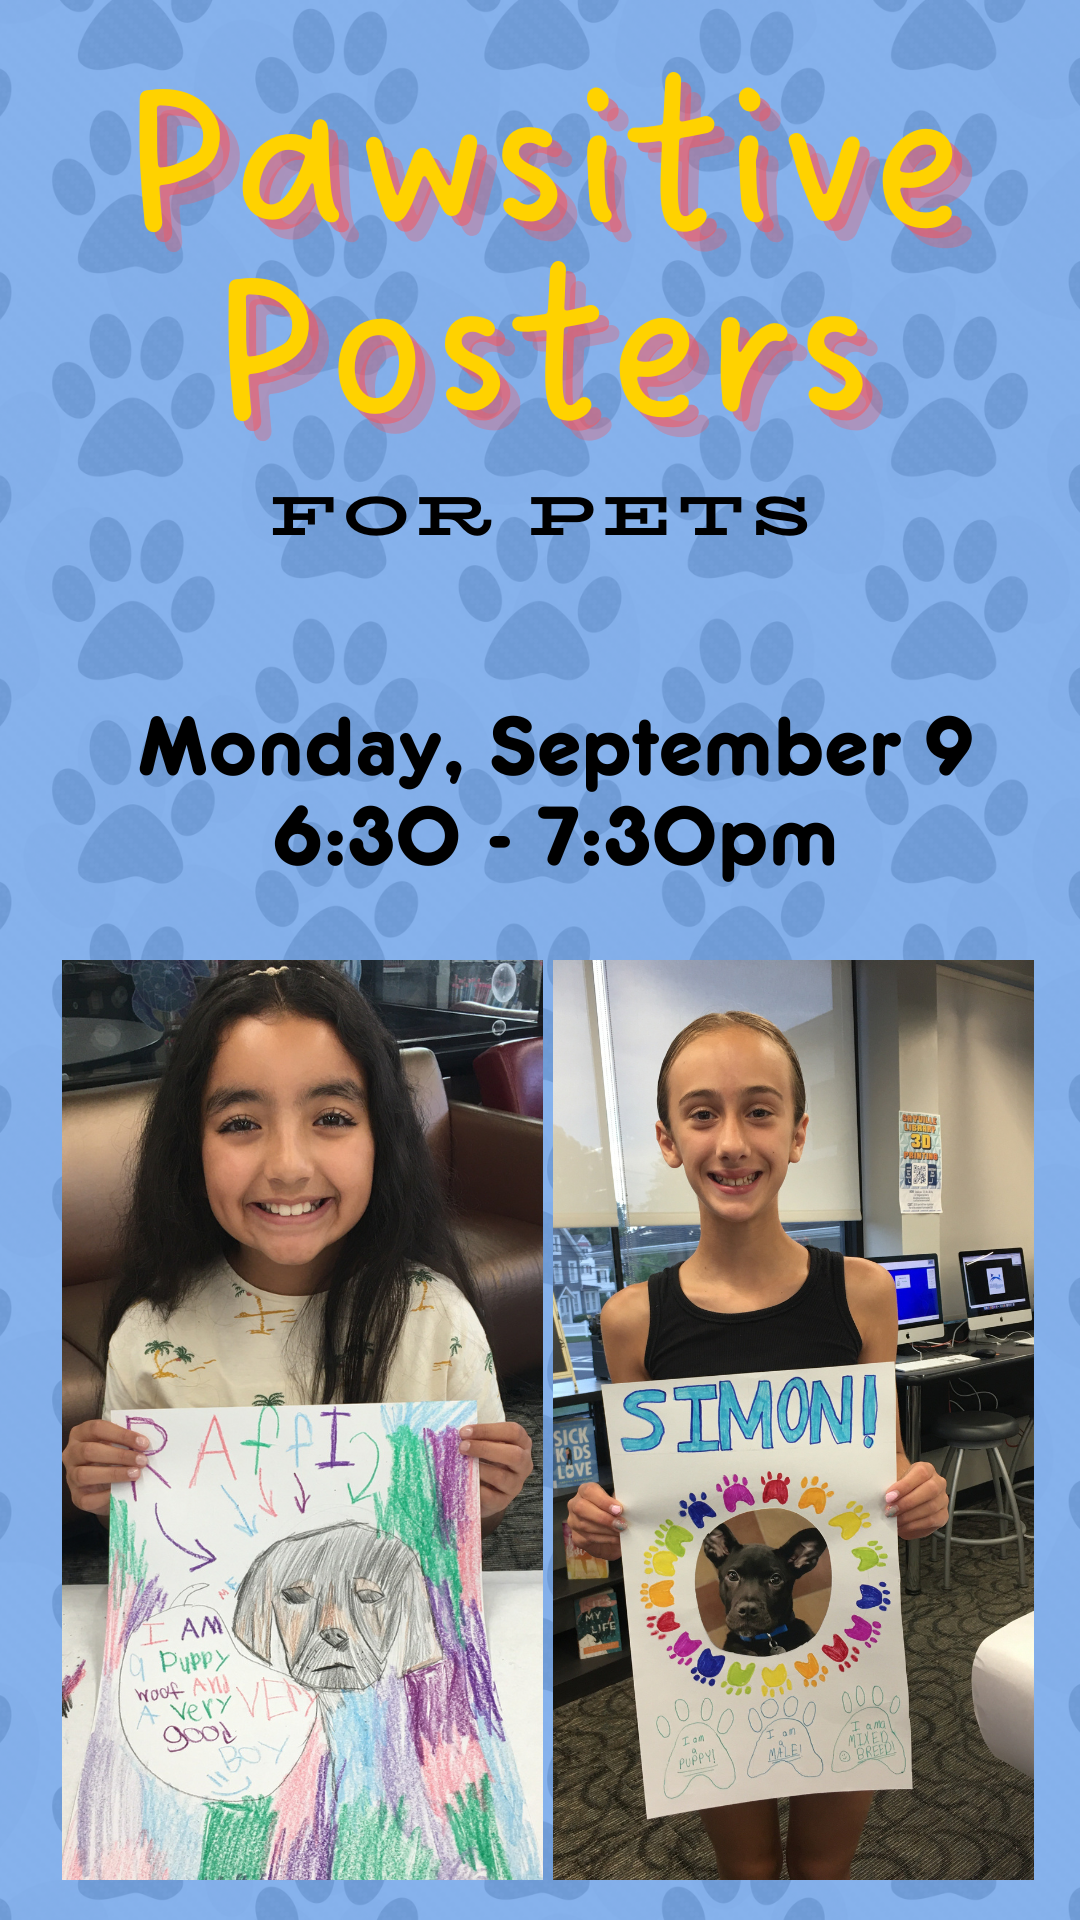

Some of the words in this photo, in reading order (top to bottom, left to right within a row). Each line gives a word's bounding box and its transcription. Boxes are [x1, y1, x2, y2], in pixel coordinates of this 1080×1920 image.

[902, 1114, 937, 1126] SAYVILLE
[904, 1123, 936, 1134] LIBRARY
[911, 1133, 932, 1150] 3D
[903, 1151, 938, 1161] PRINTING
[621, 1375, 878, 1453] SIMON!
[553, 1427, 589, 1447] SICK
[557, 1461, 592, 1479] LOVE
[585, 1610, 602, 1622] MY
[141, 1622, 168, 1646] I
[181, 1616, 223, 1641] AM
[591, 1621, 617, 1634] LIFE
[851, 1720, 861, 1731] I
[766, 1729, 774, 1740] I
[783, 1727, 796, 1737] am
[849, 1731, 889, 1748] MIXED
[682, 1736, 690, 1746] I
[693, 1735, 705, 1743] am
[219, 1735, 289, 1773] BOY
